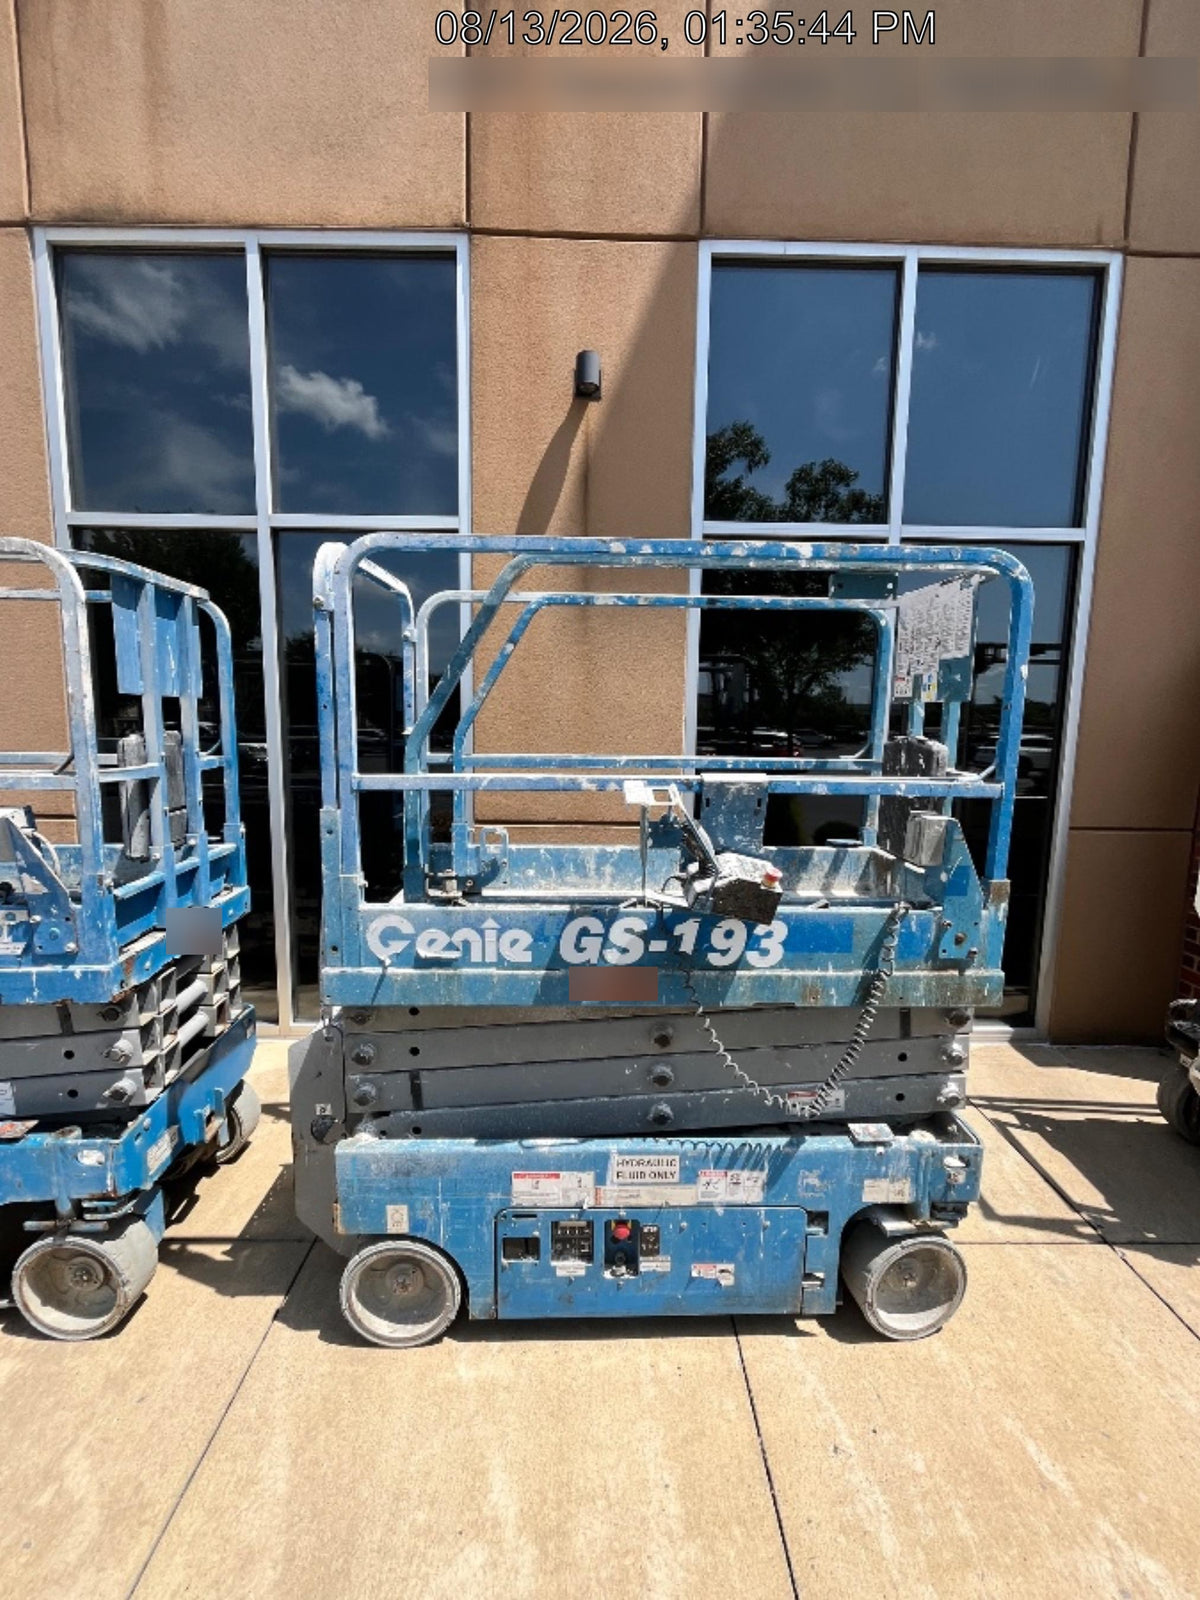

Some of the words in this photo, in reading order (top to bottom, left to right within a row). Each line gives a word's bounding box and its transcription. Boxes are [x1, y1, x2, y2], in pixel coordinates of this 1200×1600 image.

[366, 914, 534, 966] Genie
[616, 1158, 677, 1167] HYDRAULIC
[616, 1171, 646, 1179] FLUID
[648, 1171, 676, 1179] ONLY
